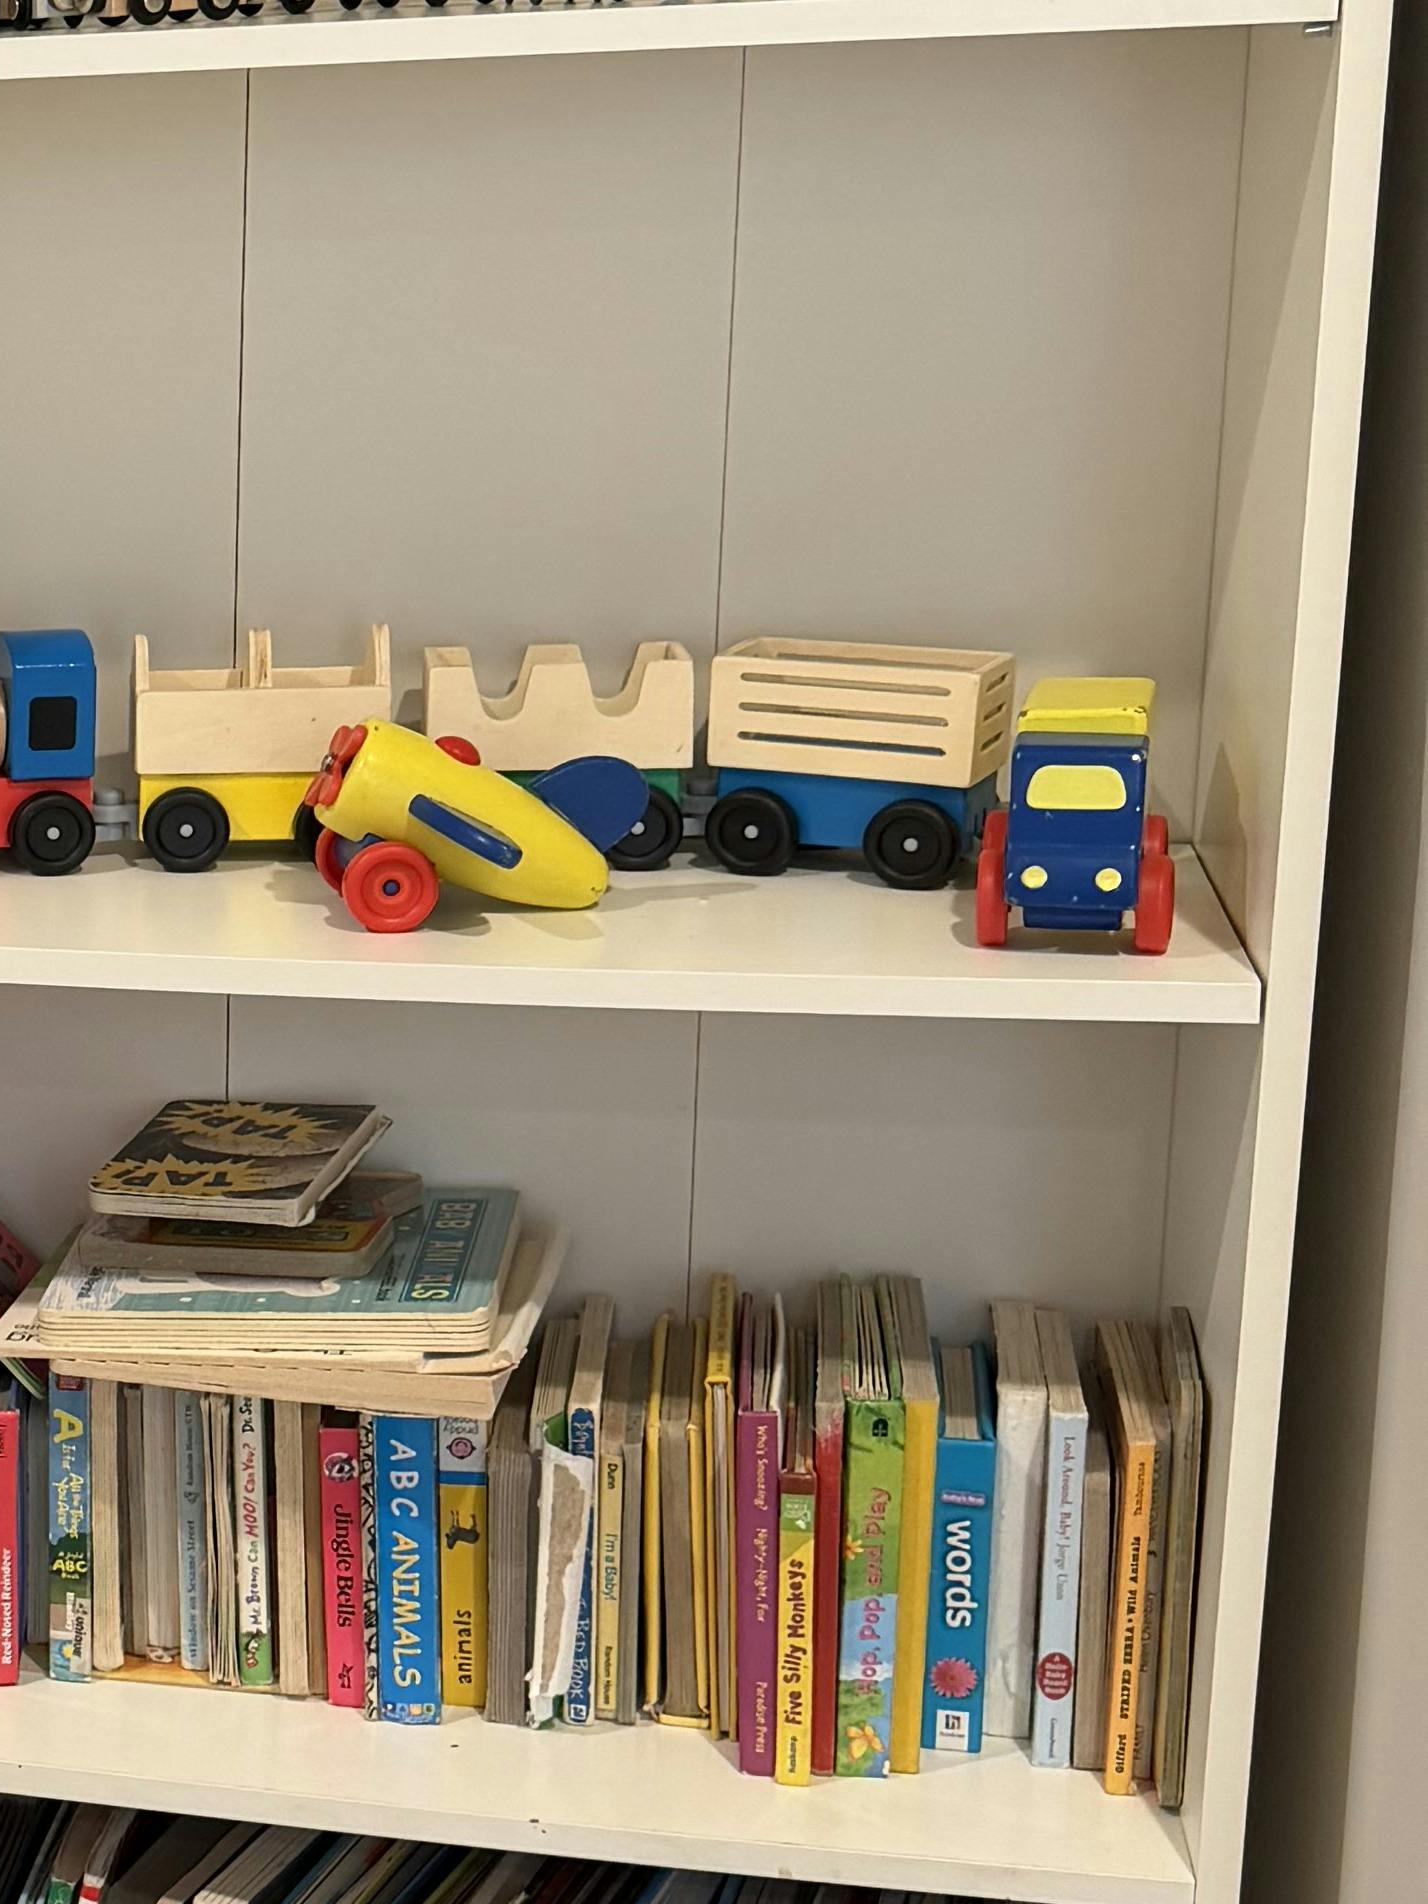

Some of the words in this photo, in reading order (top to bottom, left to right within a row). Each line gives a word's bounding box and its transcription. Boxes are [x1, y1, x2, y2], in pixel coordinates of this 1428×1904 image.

[390, 1440, 416, 1461] A
[391, 1470, 419, 1490] B
[392, 1498, 420, 1518] C
[333, 1503, 356, 1571] Jingle
[1, 1548, 12, 1597] Reindeer
[786, 1559, 808, 1638] Monkeys
[944, 1520, 976, 1628] words
[336, 1574, 358, 1628] Bells
[391, 1530, 421, 1688] ANIMALS
[1, 1600, 12, 1664] Red-Nosed
[454, 1609, 472, 1684] animals
[782, 1642, 809, 1685] Silly
[783, 1690, 804, 1725] Five
